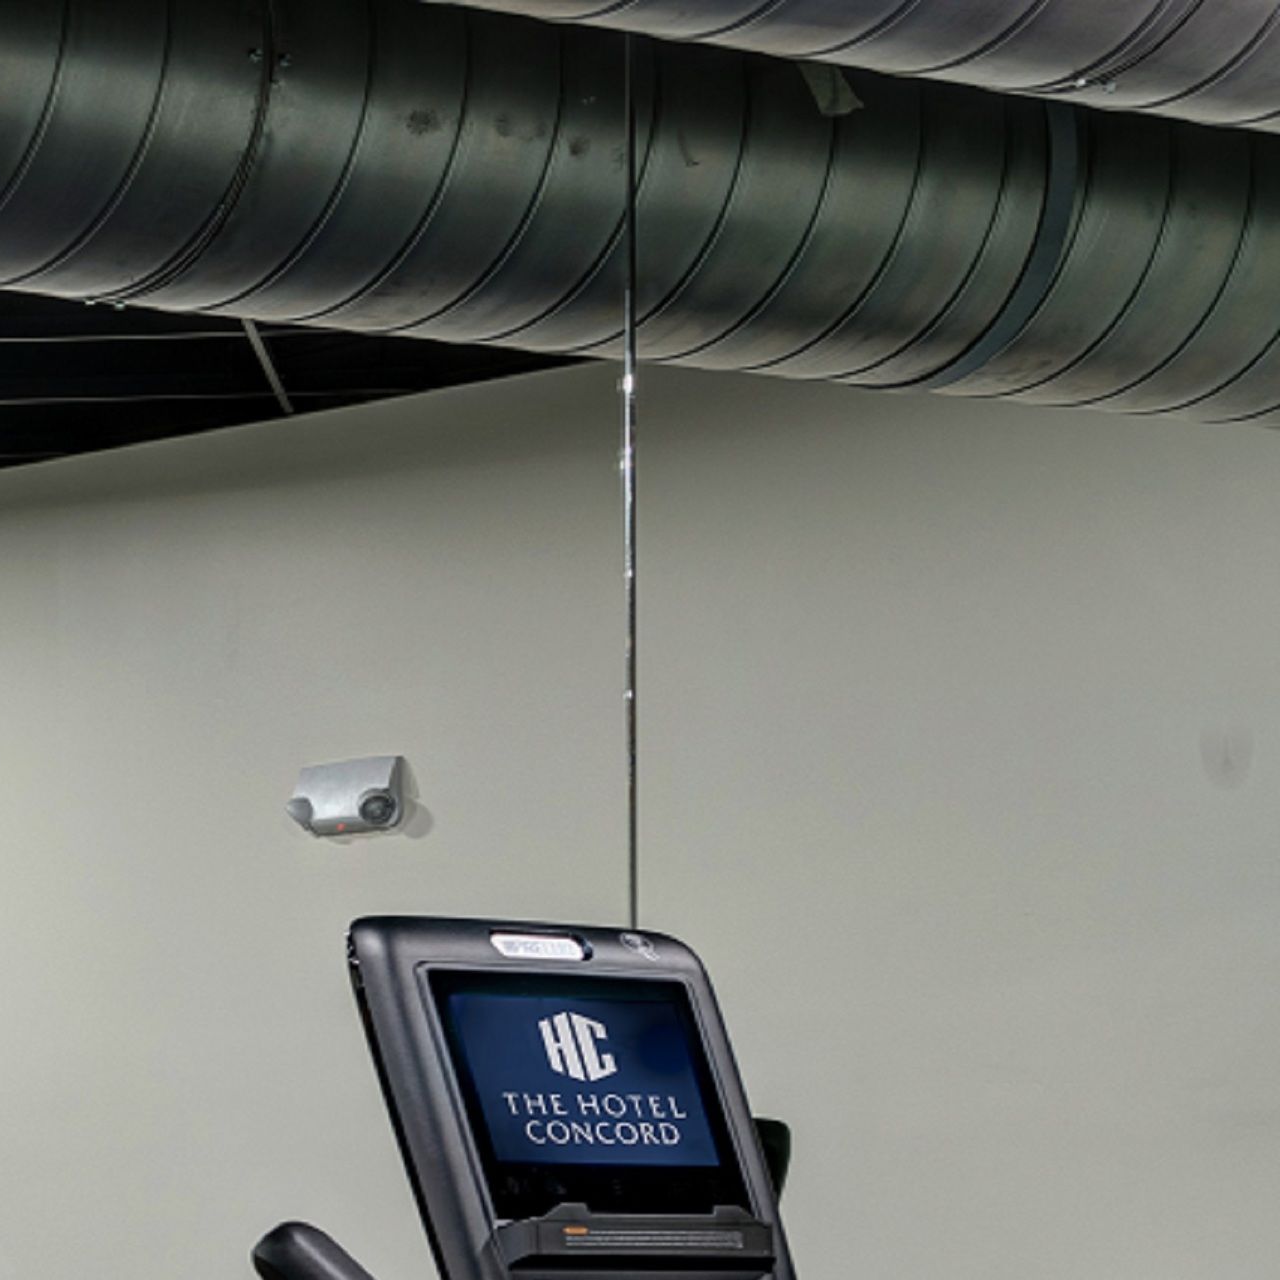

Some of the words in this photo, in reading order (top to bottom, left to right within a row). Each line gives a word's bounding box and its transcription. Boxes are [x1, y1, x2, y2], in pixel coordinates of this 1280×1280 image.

[537, 1011, 619, 1082] HC
[502, 1091, 569, 1116] THE
[576, 1093, 688, 1119] HOTEL
[524, 1119, 681, 1145] CONCORD
